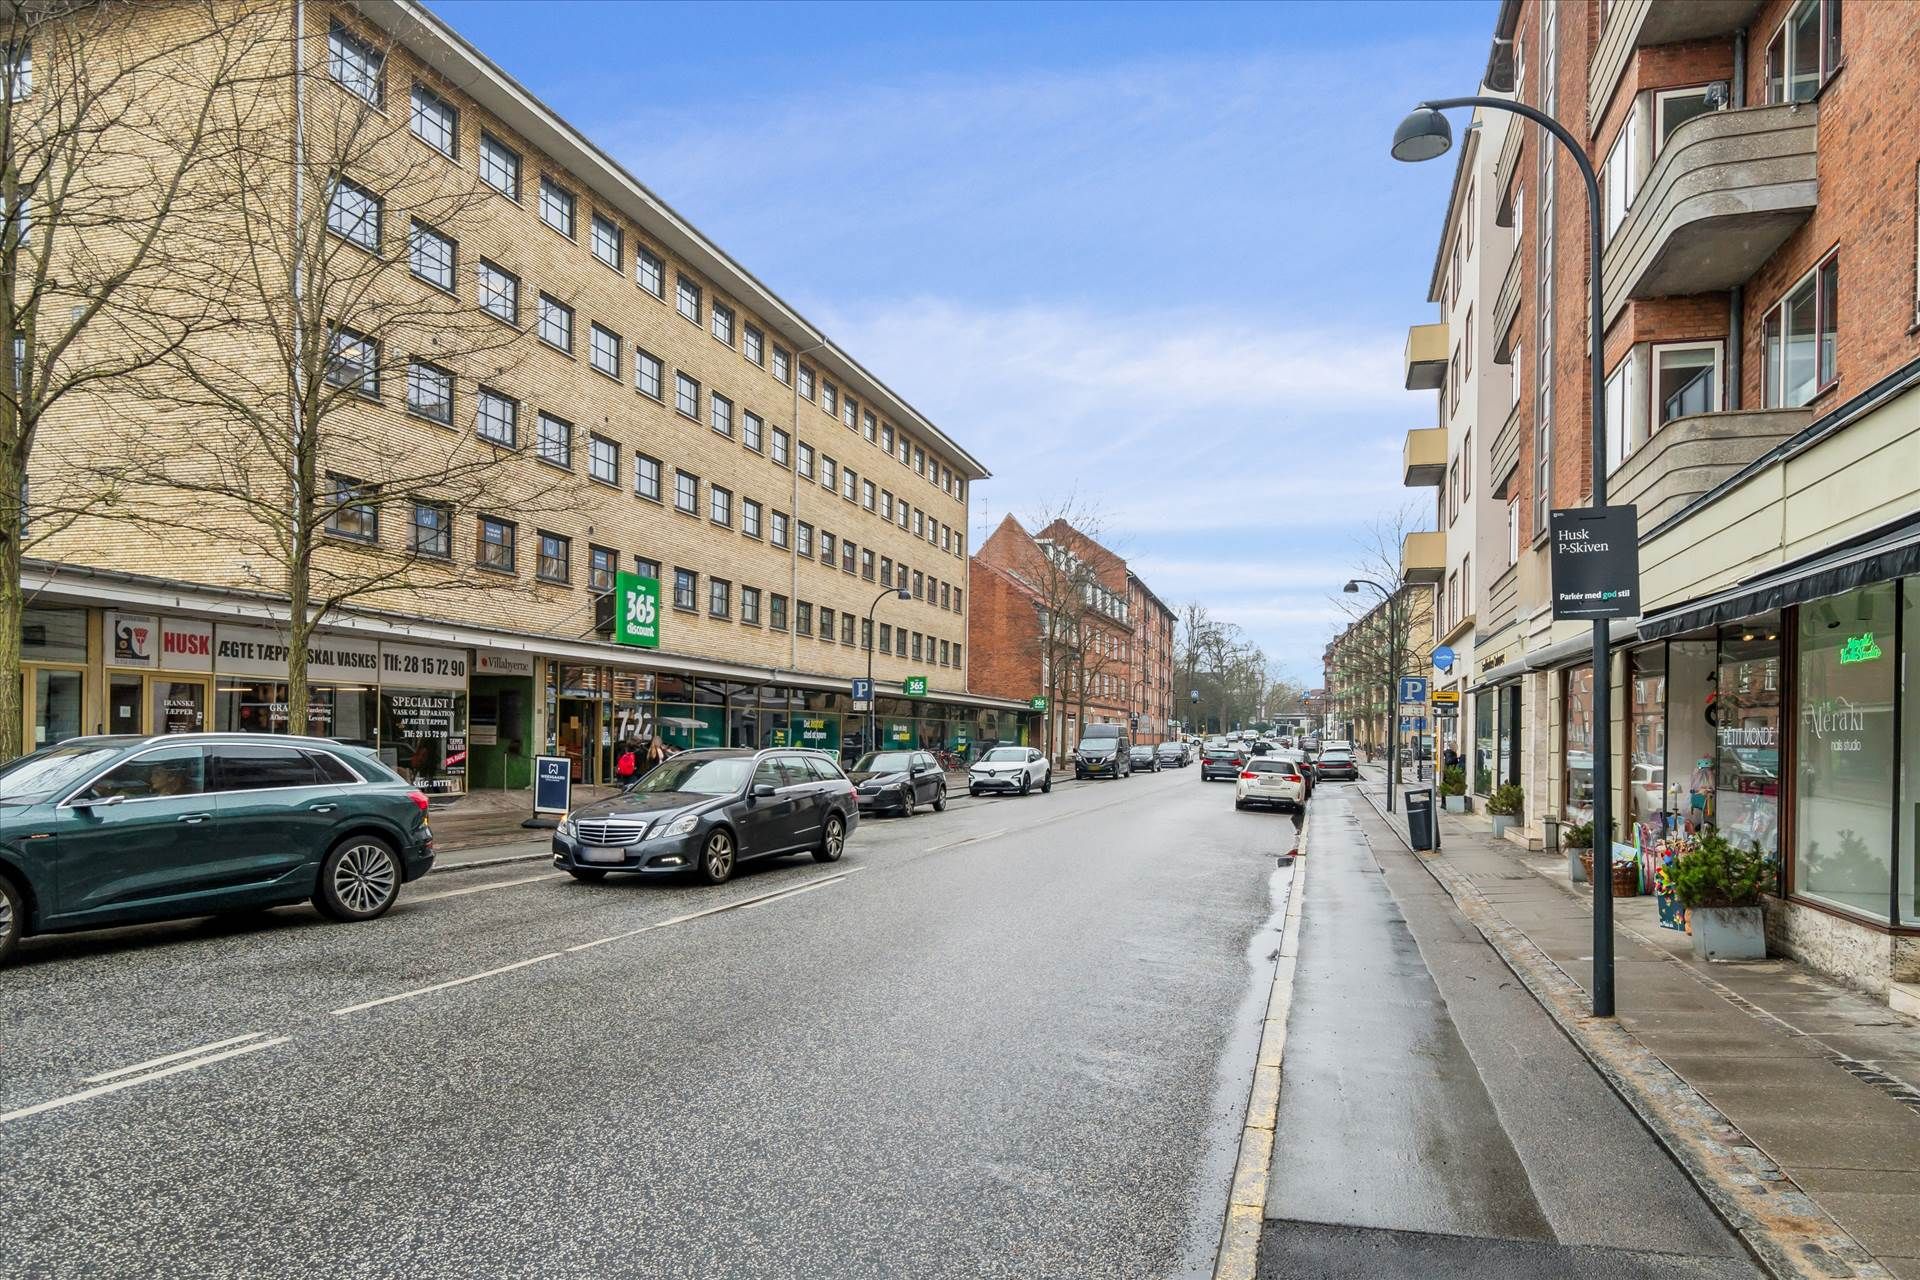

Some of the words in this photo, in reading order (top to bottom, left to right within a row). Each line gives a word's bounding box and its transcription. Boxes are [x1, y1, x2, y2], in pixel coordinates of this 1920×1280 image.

[1559, 528, 1589, 540] Husk
[1559, 541, 1609, 554] P-Skiven
[1560, 592, 1584, 600] Parkér
[1584, 590, 1602, 600] med
[1602, 590, 1617, 600] god
[1618, 589, 1631, 598] stil
[626, 590, 655, 624] 365
[626, 621, 655, 637] discount
[163, 631, 210, 655] HUSK
[218, 640, 254, 659] ÆGTE
[256, 643, 290, 662] TÆPP
[307, 648, 335, 666] SKAL
[337, 651, 377, 669] VASKES
[383, 653, 402, 671] Tlf:
[404, 655, 419, 673] 28
[421, 657, 434, 674] 15
[436, 658, 449, 676] 72
[451, 660, 465, 677] 90
[856, 682, 868, 698] P
[909, 681, 924, 690] 365
[1404, 681, 1423, 700] P
[163, 699, 195, 707] IRANSKE
[392, 696, 449, 709] SPECIALIST
[308, 715, 332, 723] Levering
[420, 709, 455, 717] REPARATION
[415, 730, 424, 738] 28
[424, 730, 432, 738] 15
[432, 730, 440, 738] 72
[1743, 727, 1775, 745] MONDE
[1844, 739, 1862, 751] studio
